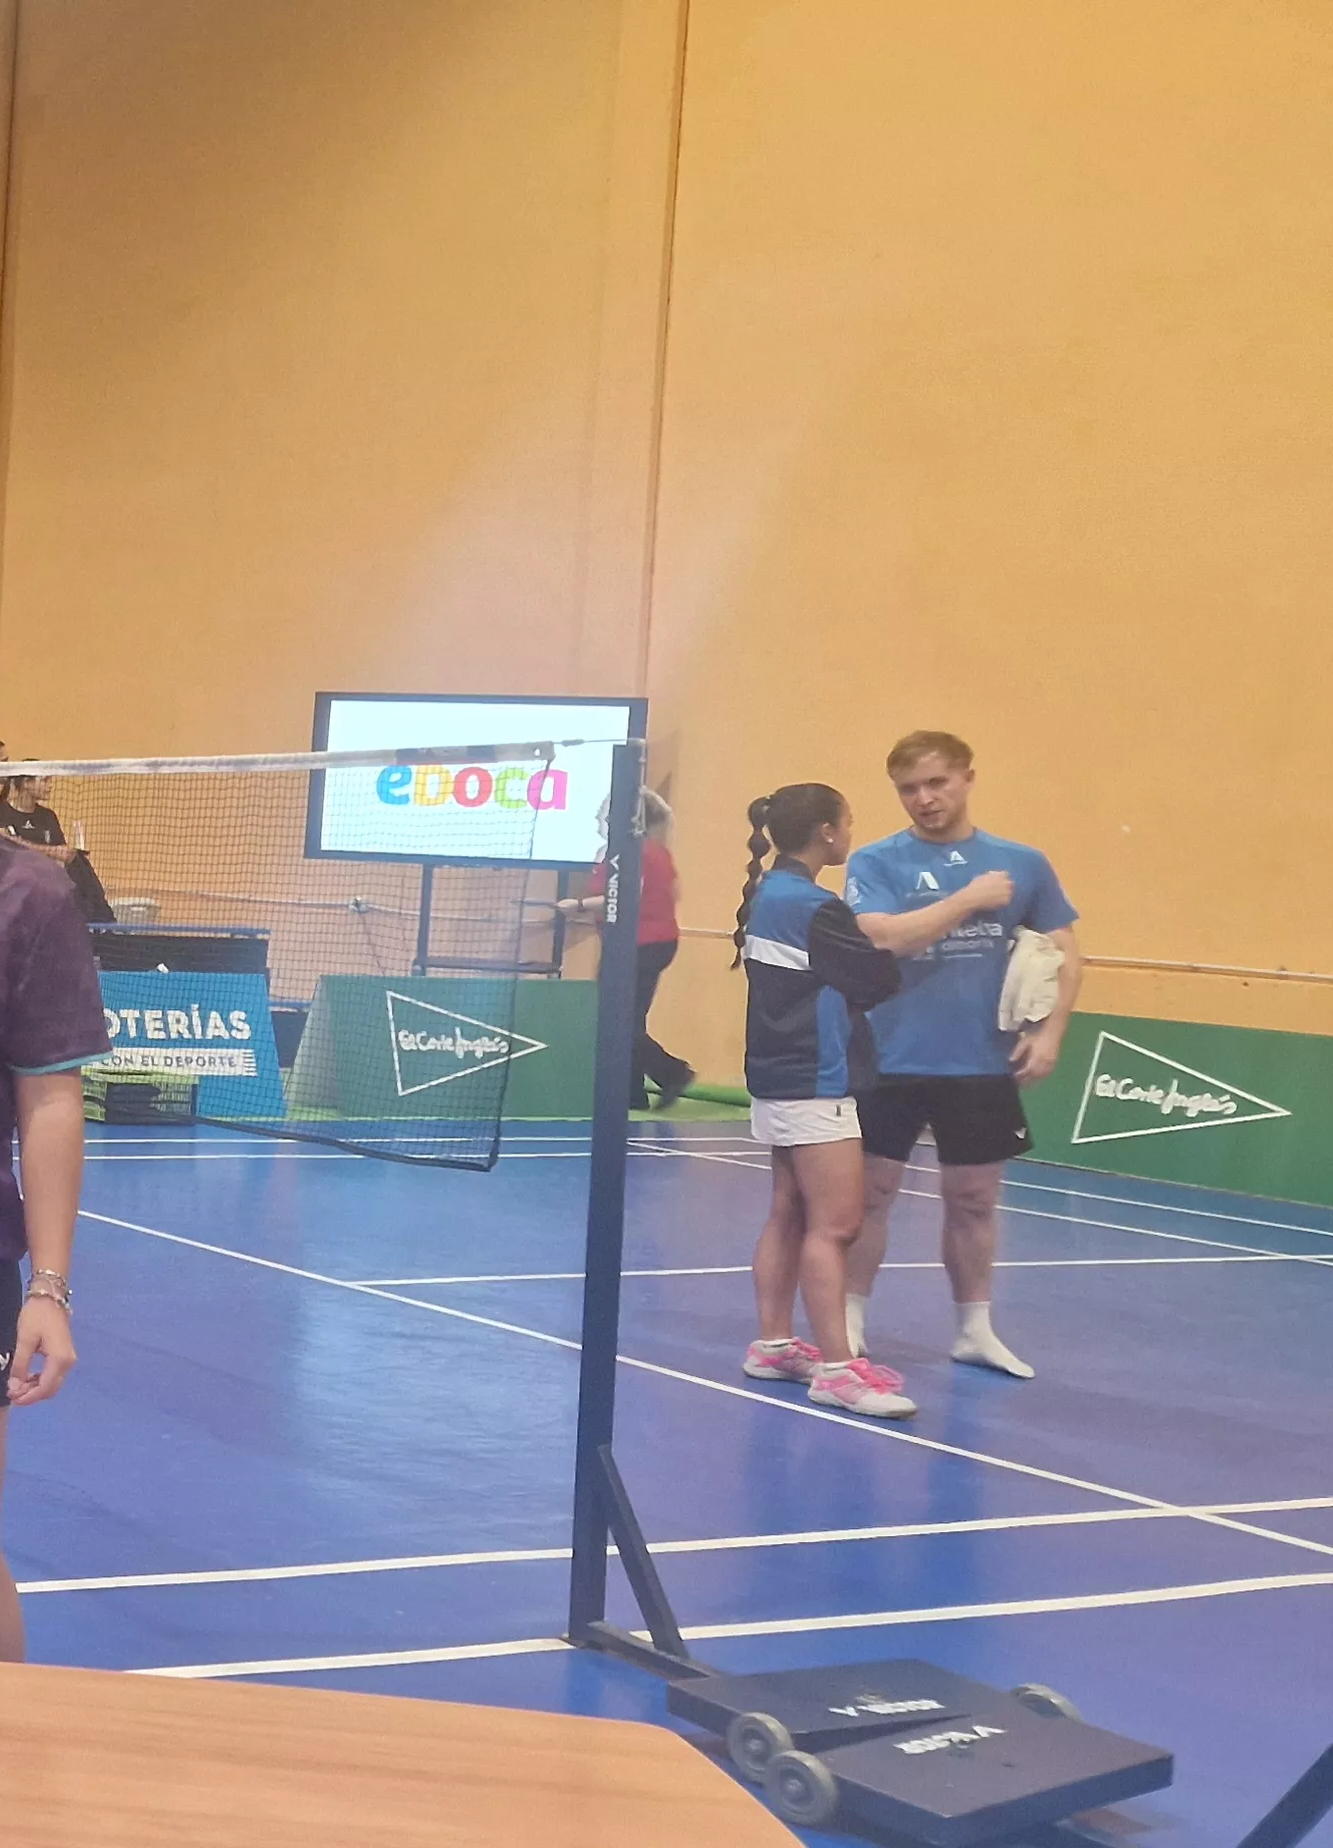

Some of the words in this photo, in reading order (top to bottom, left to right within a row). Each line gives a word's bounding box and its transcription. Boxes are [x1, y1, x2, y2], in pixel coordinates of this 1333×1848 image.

[606, 873, 619, 923] VICTOR
[102, 1003, 252, 1041] OTERÍAS
[141, 1055, 159, 1067] EL
[163, 1055, 237, 1068] DEPORTE
